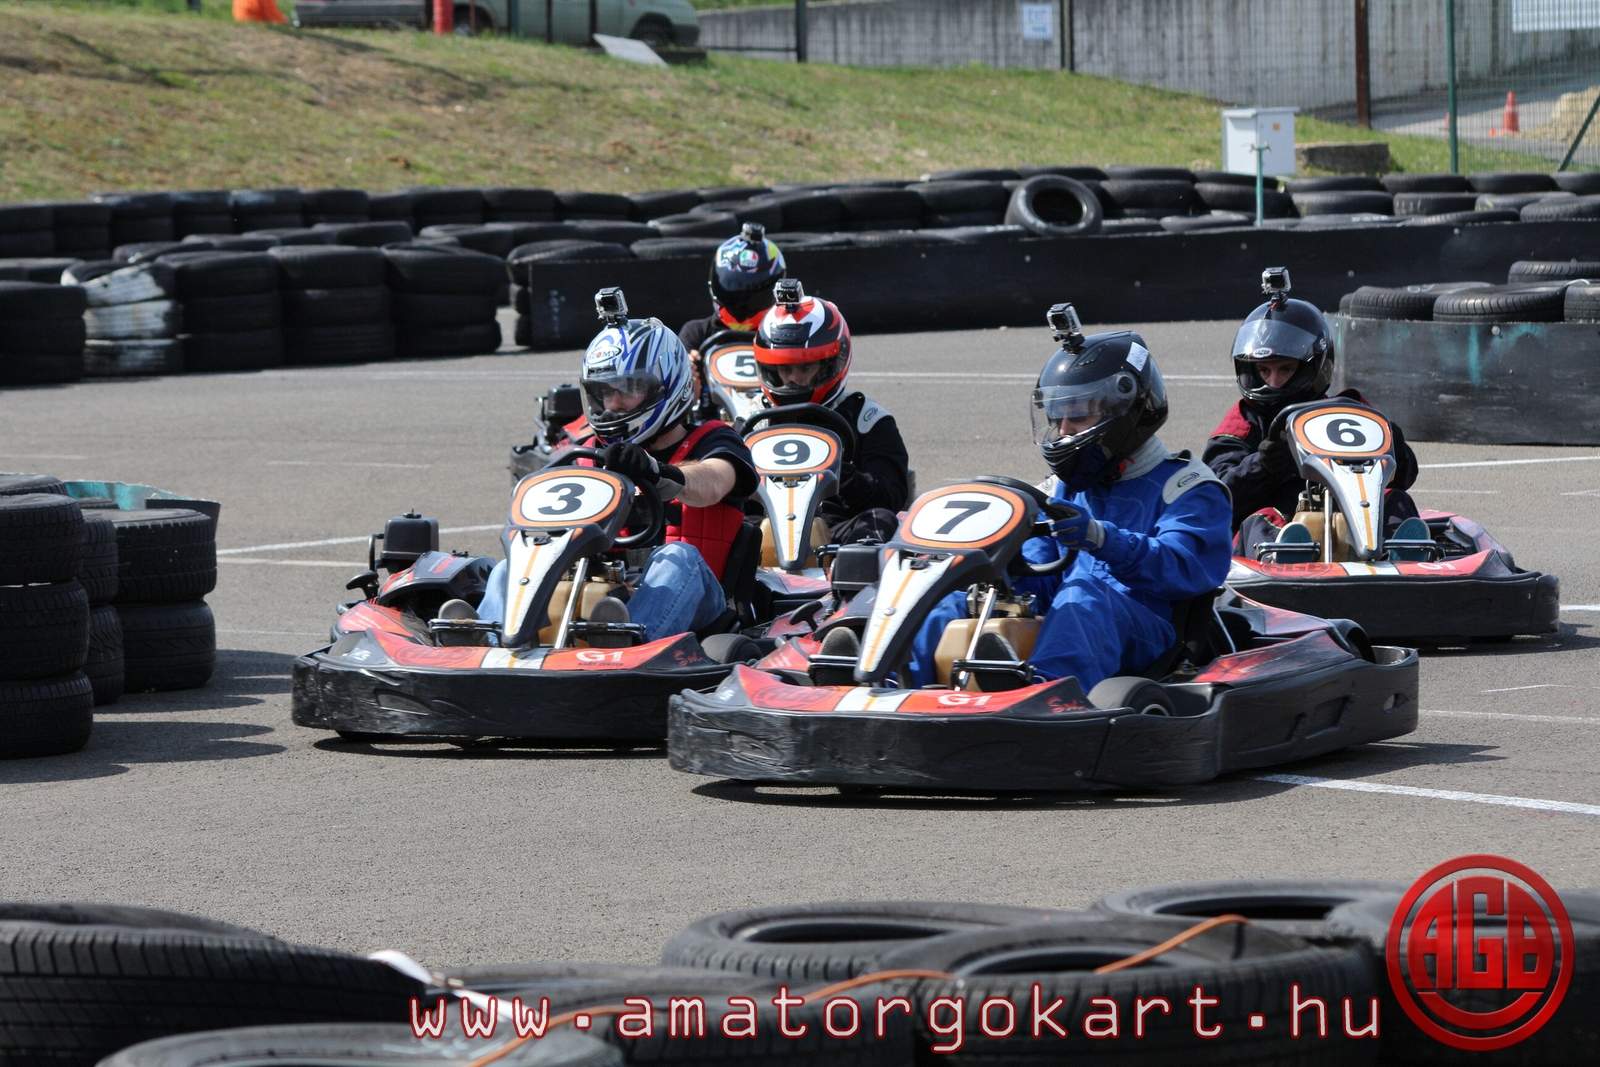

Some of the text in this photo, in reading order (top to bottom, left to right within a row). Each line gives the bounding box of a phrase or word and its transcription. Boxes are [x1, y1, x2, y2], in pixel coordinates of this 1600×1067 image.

[735, 355, 758, 377] 5
[1326, 418, 1367, 447] 6
[772, 439, 811, 466] 9
[537, 482, 586, 515] 3
[935, 500, 992, 535] 7
[575, 650, 624, 663] G1
[937, 693, 992, 707] G1
